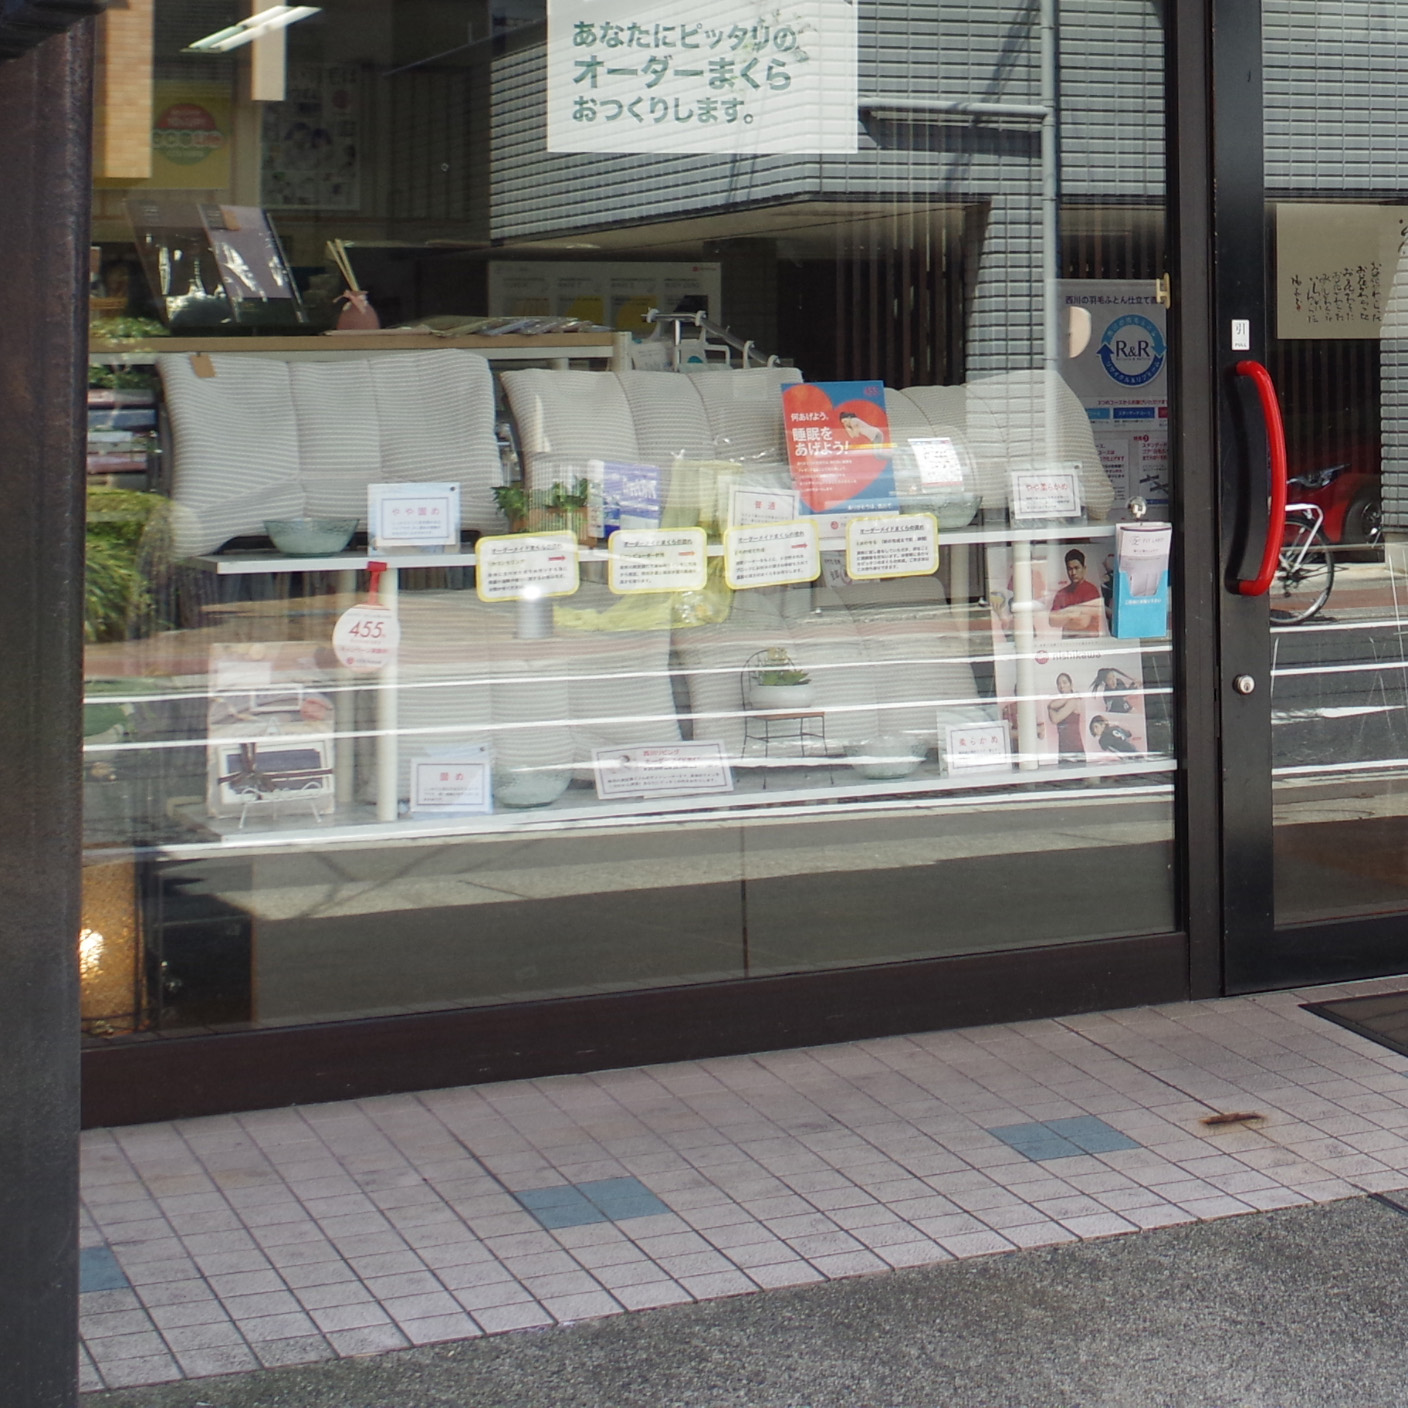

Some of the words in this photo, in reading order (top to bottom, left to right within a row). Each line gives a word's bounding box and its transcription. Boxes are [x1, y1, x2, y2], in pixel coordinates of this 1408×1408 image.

[572, 18, 797, 54] あなたにピッタリの
[572, 56, 792, 91] オーダーまくら
[572, 94, 755, 125] おつくりします。
[1116, 340, 1150, 358] R&R
[792, 427, 833, 442] 睡眠を
